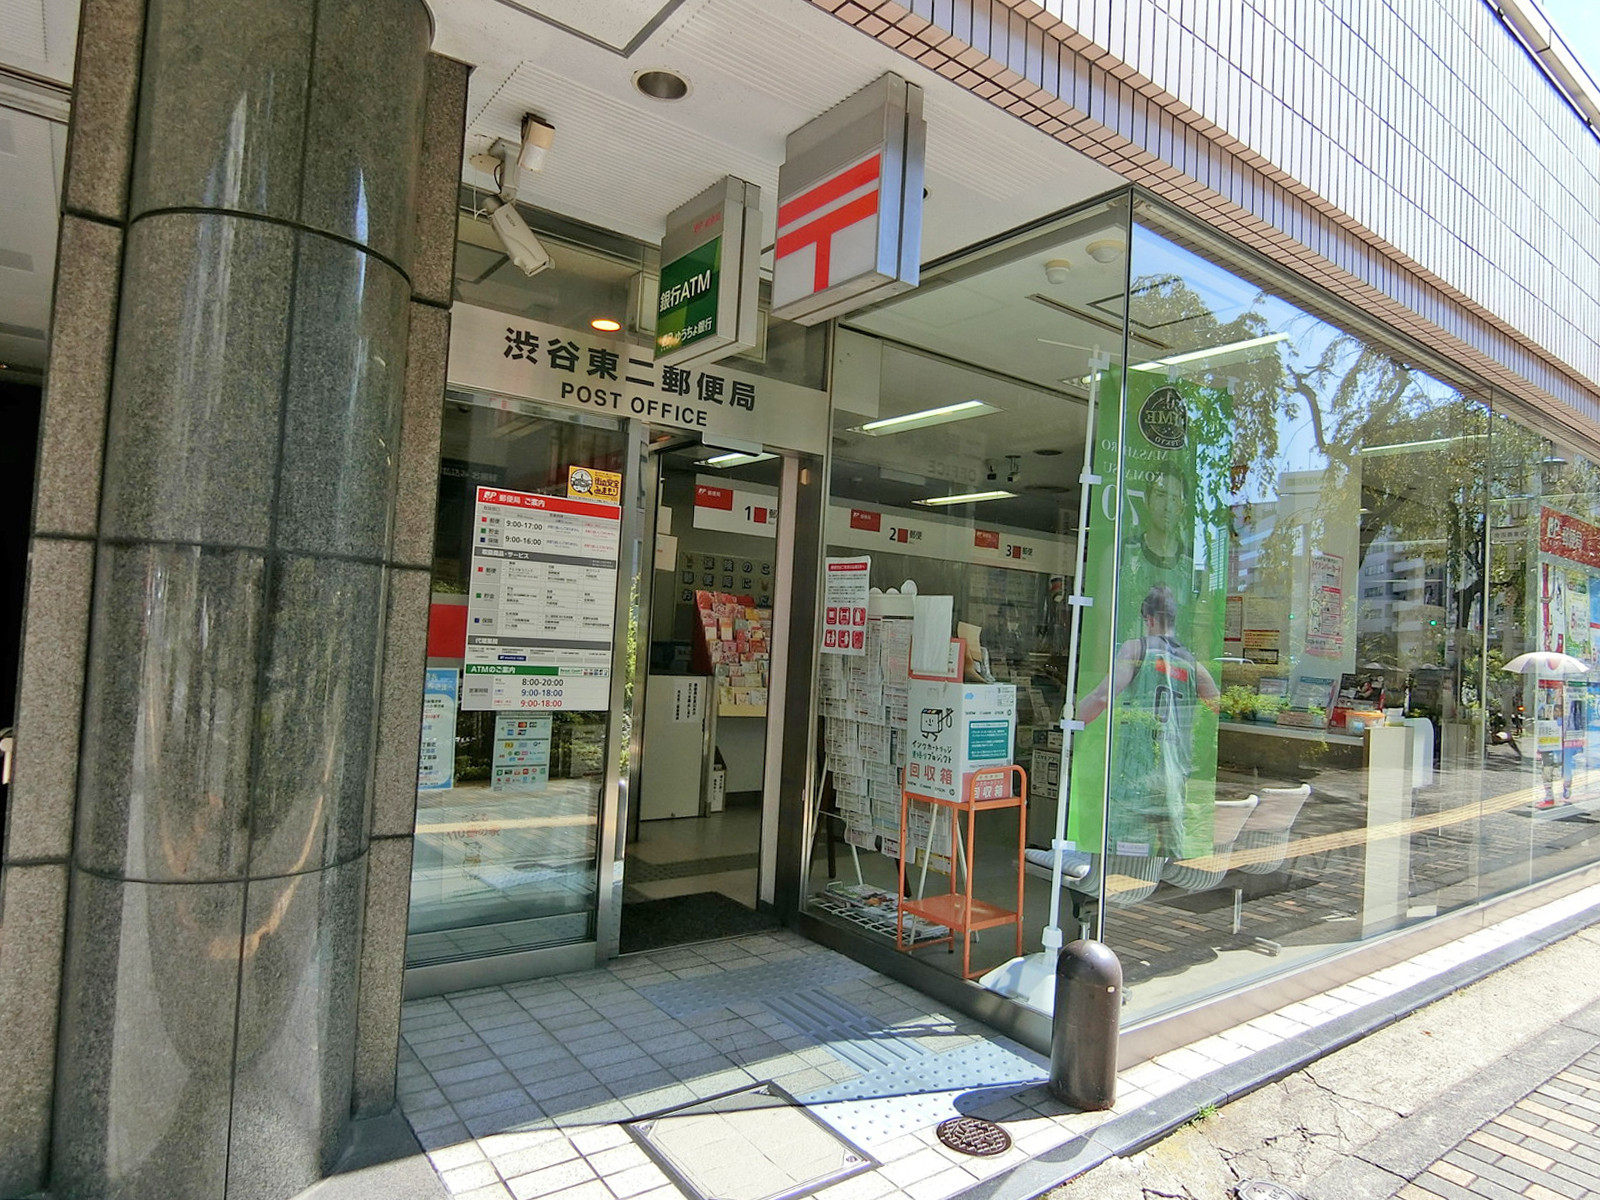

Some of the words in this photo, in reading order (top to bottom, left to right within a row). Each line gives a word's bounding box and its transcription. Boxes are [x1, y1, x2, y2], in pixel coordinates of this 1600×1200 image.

[659, 270, 712, 312] 銀行ATM
[674, 317, 713, 344] ゆうちょ銀行
[503, 327, 756, 412] 渋谷東二郵便局
[560, 382, 623, 409] POST
[630, 396, 708, 427] OFFICE
[498, 494, 521, 504] 郵便局
[524, 497, 546, 508] ご案内
[745, 506, 751, 521] 1
[506, 520, 543, 530] 9:00-17:00
[505, 535, 542, 546] 9:00-16:00
[889, 527, 897, 541] 2
[909, 530, 922, 541] 郵便
[1006, 544, 1012, 557] 3
[471, 665, 516, 674] ATMのご案内
[522, 678, 564, 687] 8:00-20:00
[521, 688, 563, 697] 9:00-18:00
[520, 699, 563, 708] 9:00-18:00
[912, 740, 953, 754] インクカートリッジ
[910, 762, 953, 786] 回収箱
